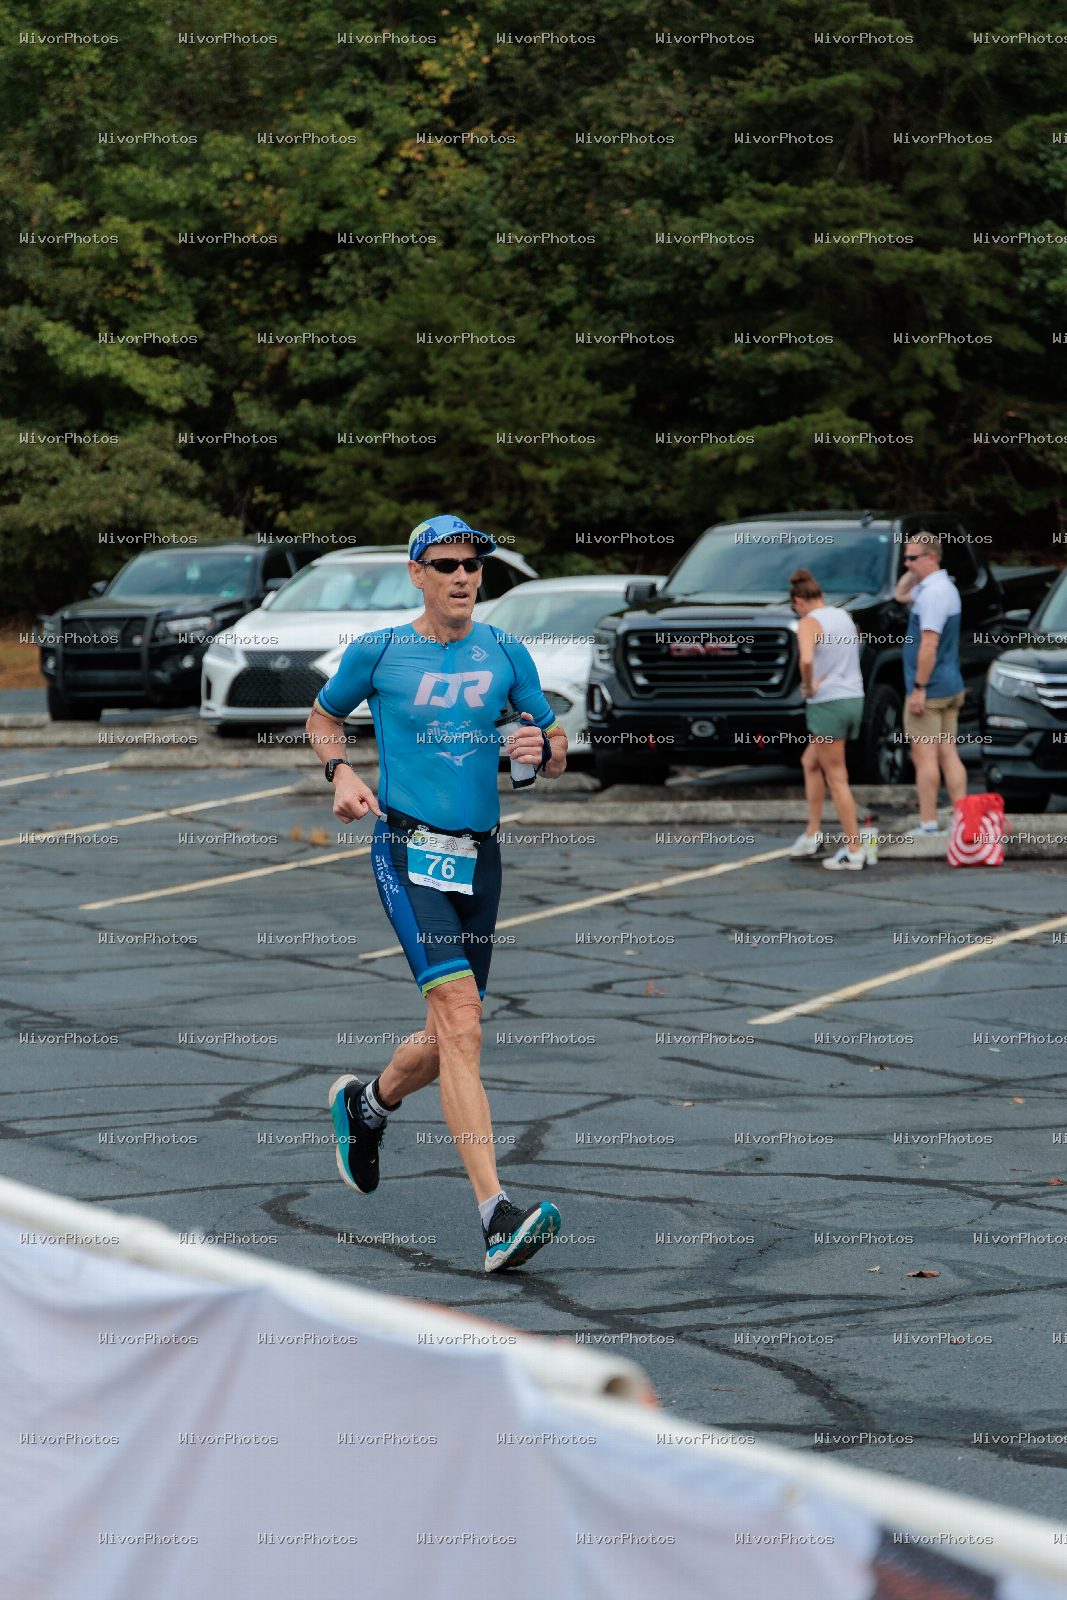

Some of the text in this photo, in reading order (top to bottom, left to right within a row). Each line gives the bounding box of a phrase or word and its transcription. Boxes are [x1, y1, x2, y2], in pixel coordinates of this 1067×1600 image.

[668, 641, 739, 657] GMC
[413, 670, 494, 709] DR
[425, 853, 456, 880] 76
